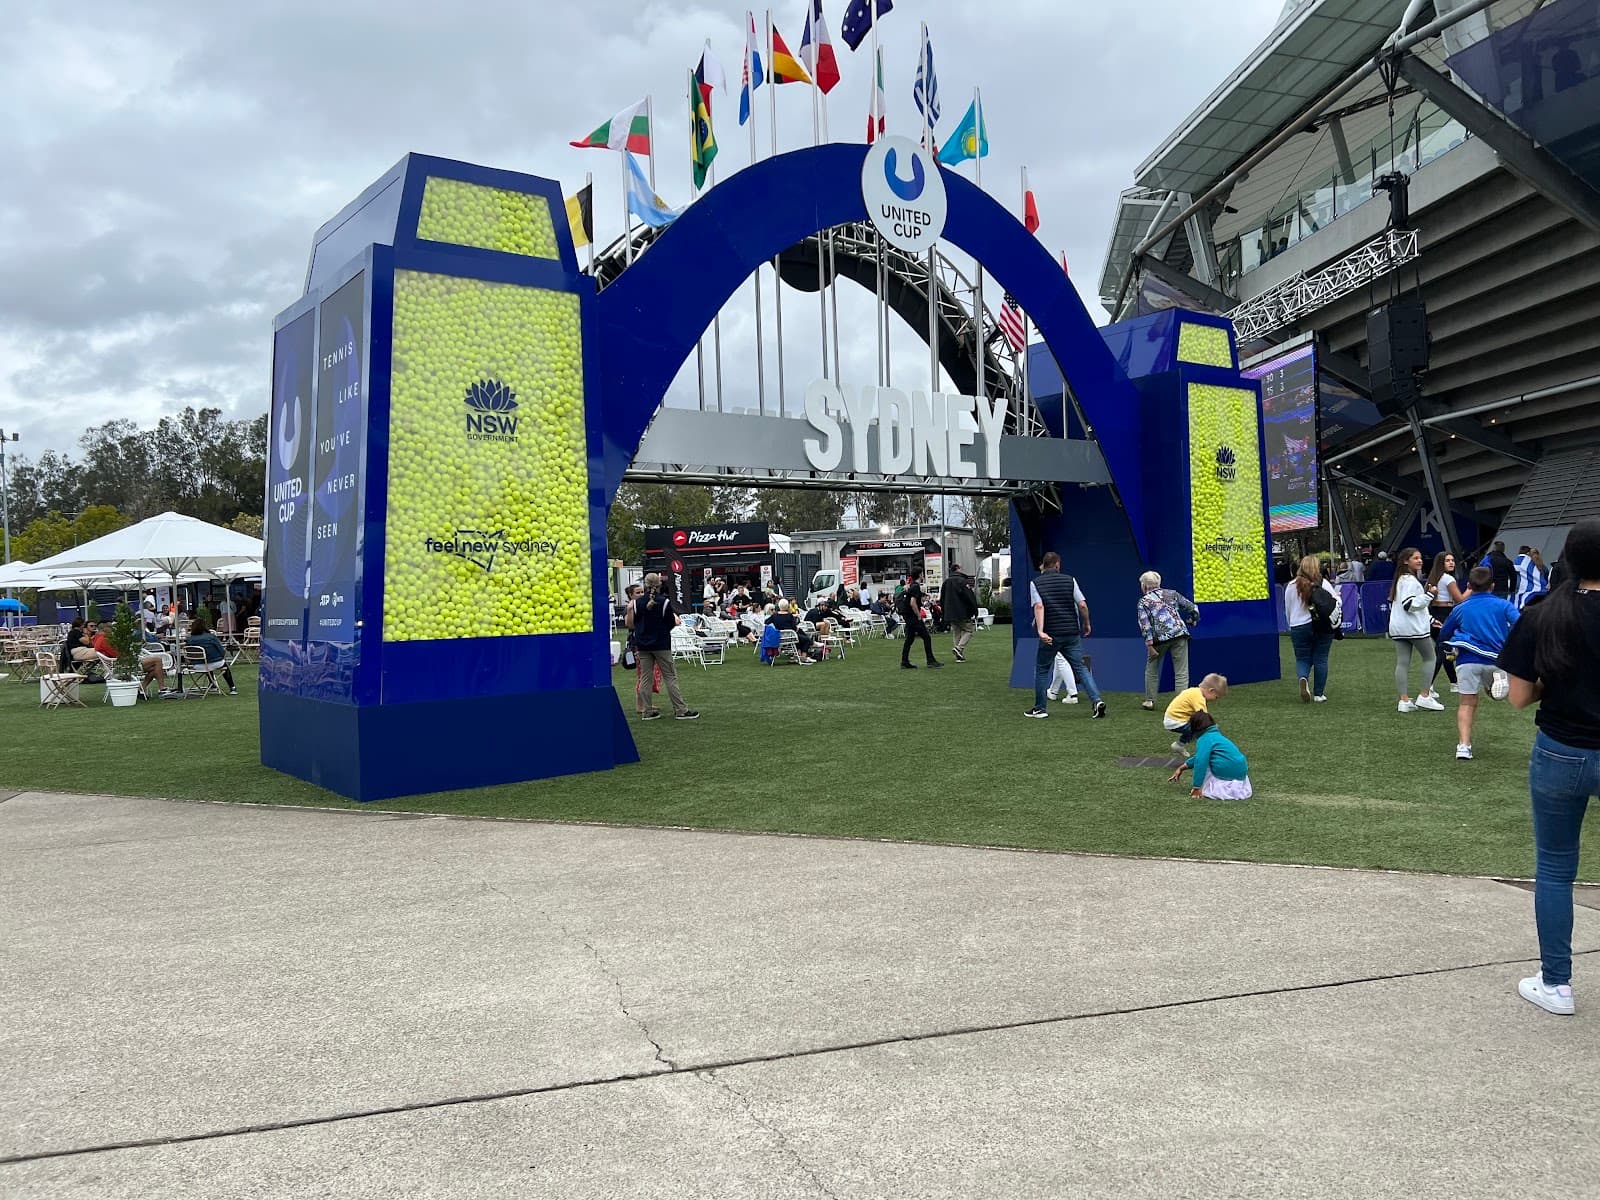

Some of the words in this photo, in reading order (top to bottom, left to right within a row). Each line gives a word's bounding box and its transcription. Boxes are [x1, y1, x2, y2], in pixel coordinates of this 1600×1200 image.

[881, 203, 931, 226] UNITED
[893, 223, 922, 240] CUP
[323, 341, 353, 370] TENNIS
[339, 382, 358, 404] LIKE
[466, 413, 518, 434] NSW
[803, 379, 1008, 480] SYDNEY
[320, 430, 350, 455] YOU'VE
[467, 434, 519, 443] GOVERNMENT
[327, 473, 355, 495] NEVER
[1216, 467, 1236, 479] NSW
[274, 477, 302, 503] UNITED
[279, 501, 295, 523] CUP
[317, 522, 338, 540] SEEN
[688, 530, 716, 544] Pizza
[716, 529, 740, 542] Hut
[425, 537, 458, 553] feel
[462, 541, 499, 553] new
[502, 537, 559, 556] sydney
